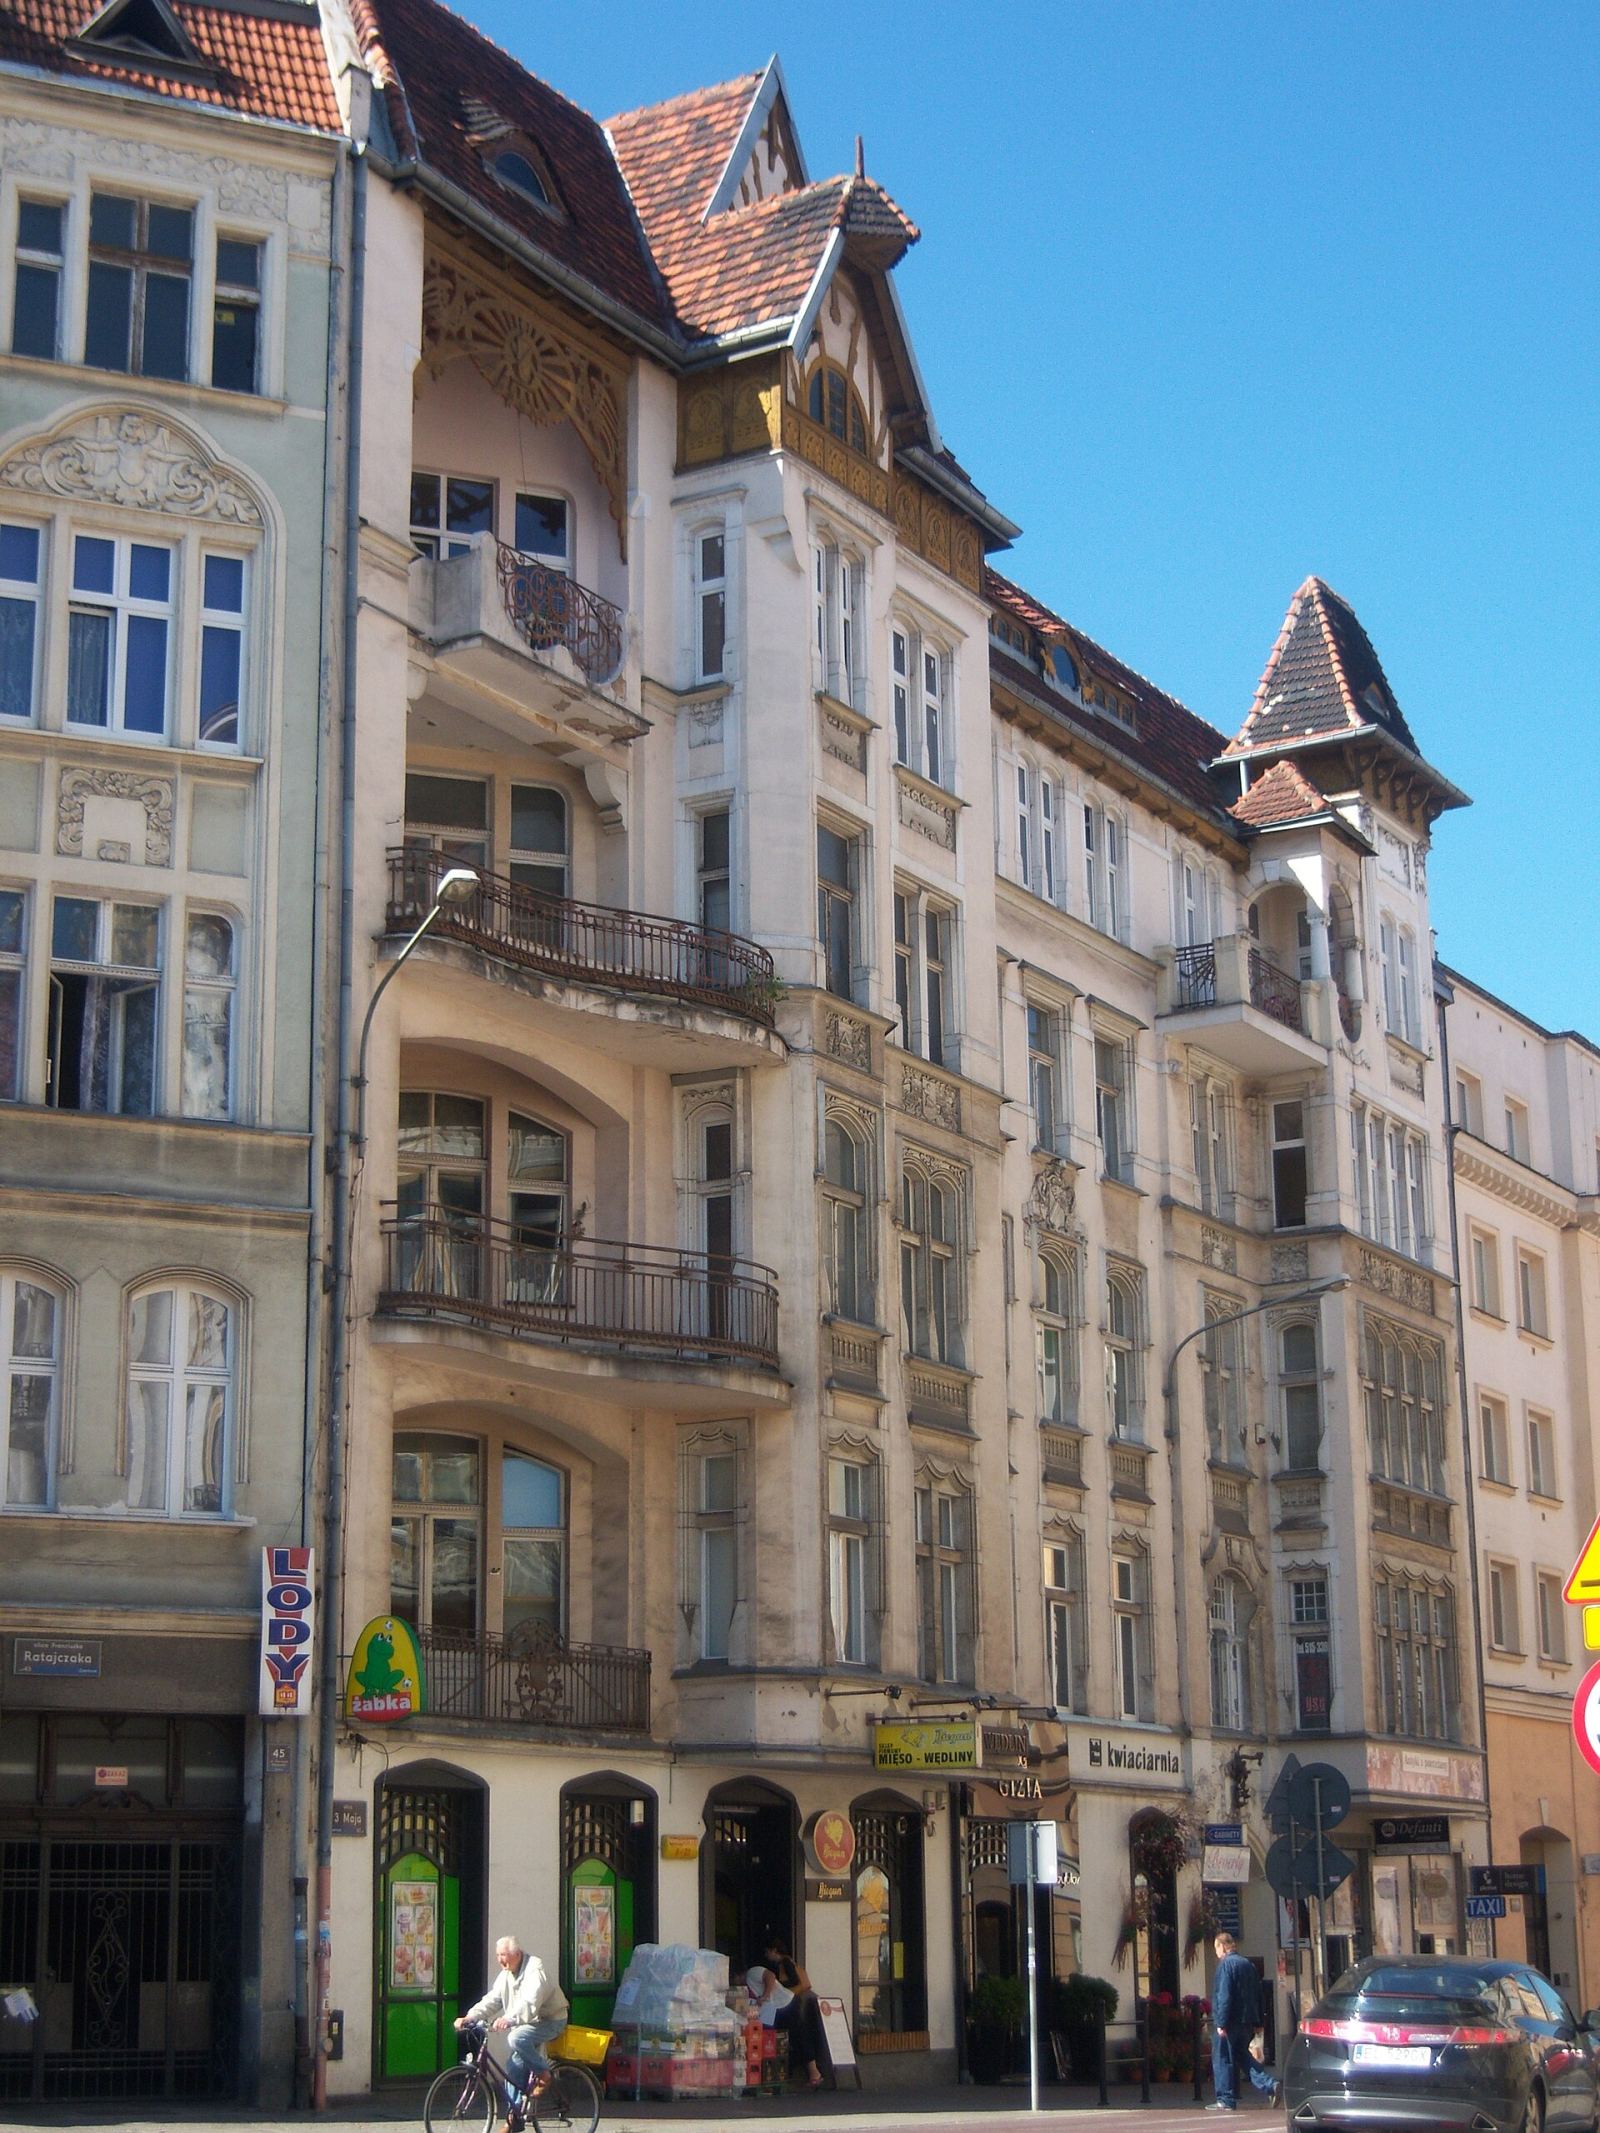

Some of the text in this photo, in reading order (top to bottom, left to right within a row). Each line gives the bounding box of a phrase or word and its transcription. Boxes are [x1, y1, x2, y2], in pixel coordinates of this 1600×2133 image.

[266, 1549, 313, 1681] LODY
[24, 1650, 92, 1665] Ratajczaka
[352, 1693, 411, 1713] żabka
[272, 1748, 286, 1759] 45
[878, 1752, 913, 1766] MIĘSO
[924, 1750, 974, 1765] WĘDLINY
[1107, 1740, 1179, 1773] kwiaciarnia
[334, 1811, 362, 1826] 3 Maja
[1467, 1898, 1501, 1916] TAXI
